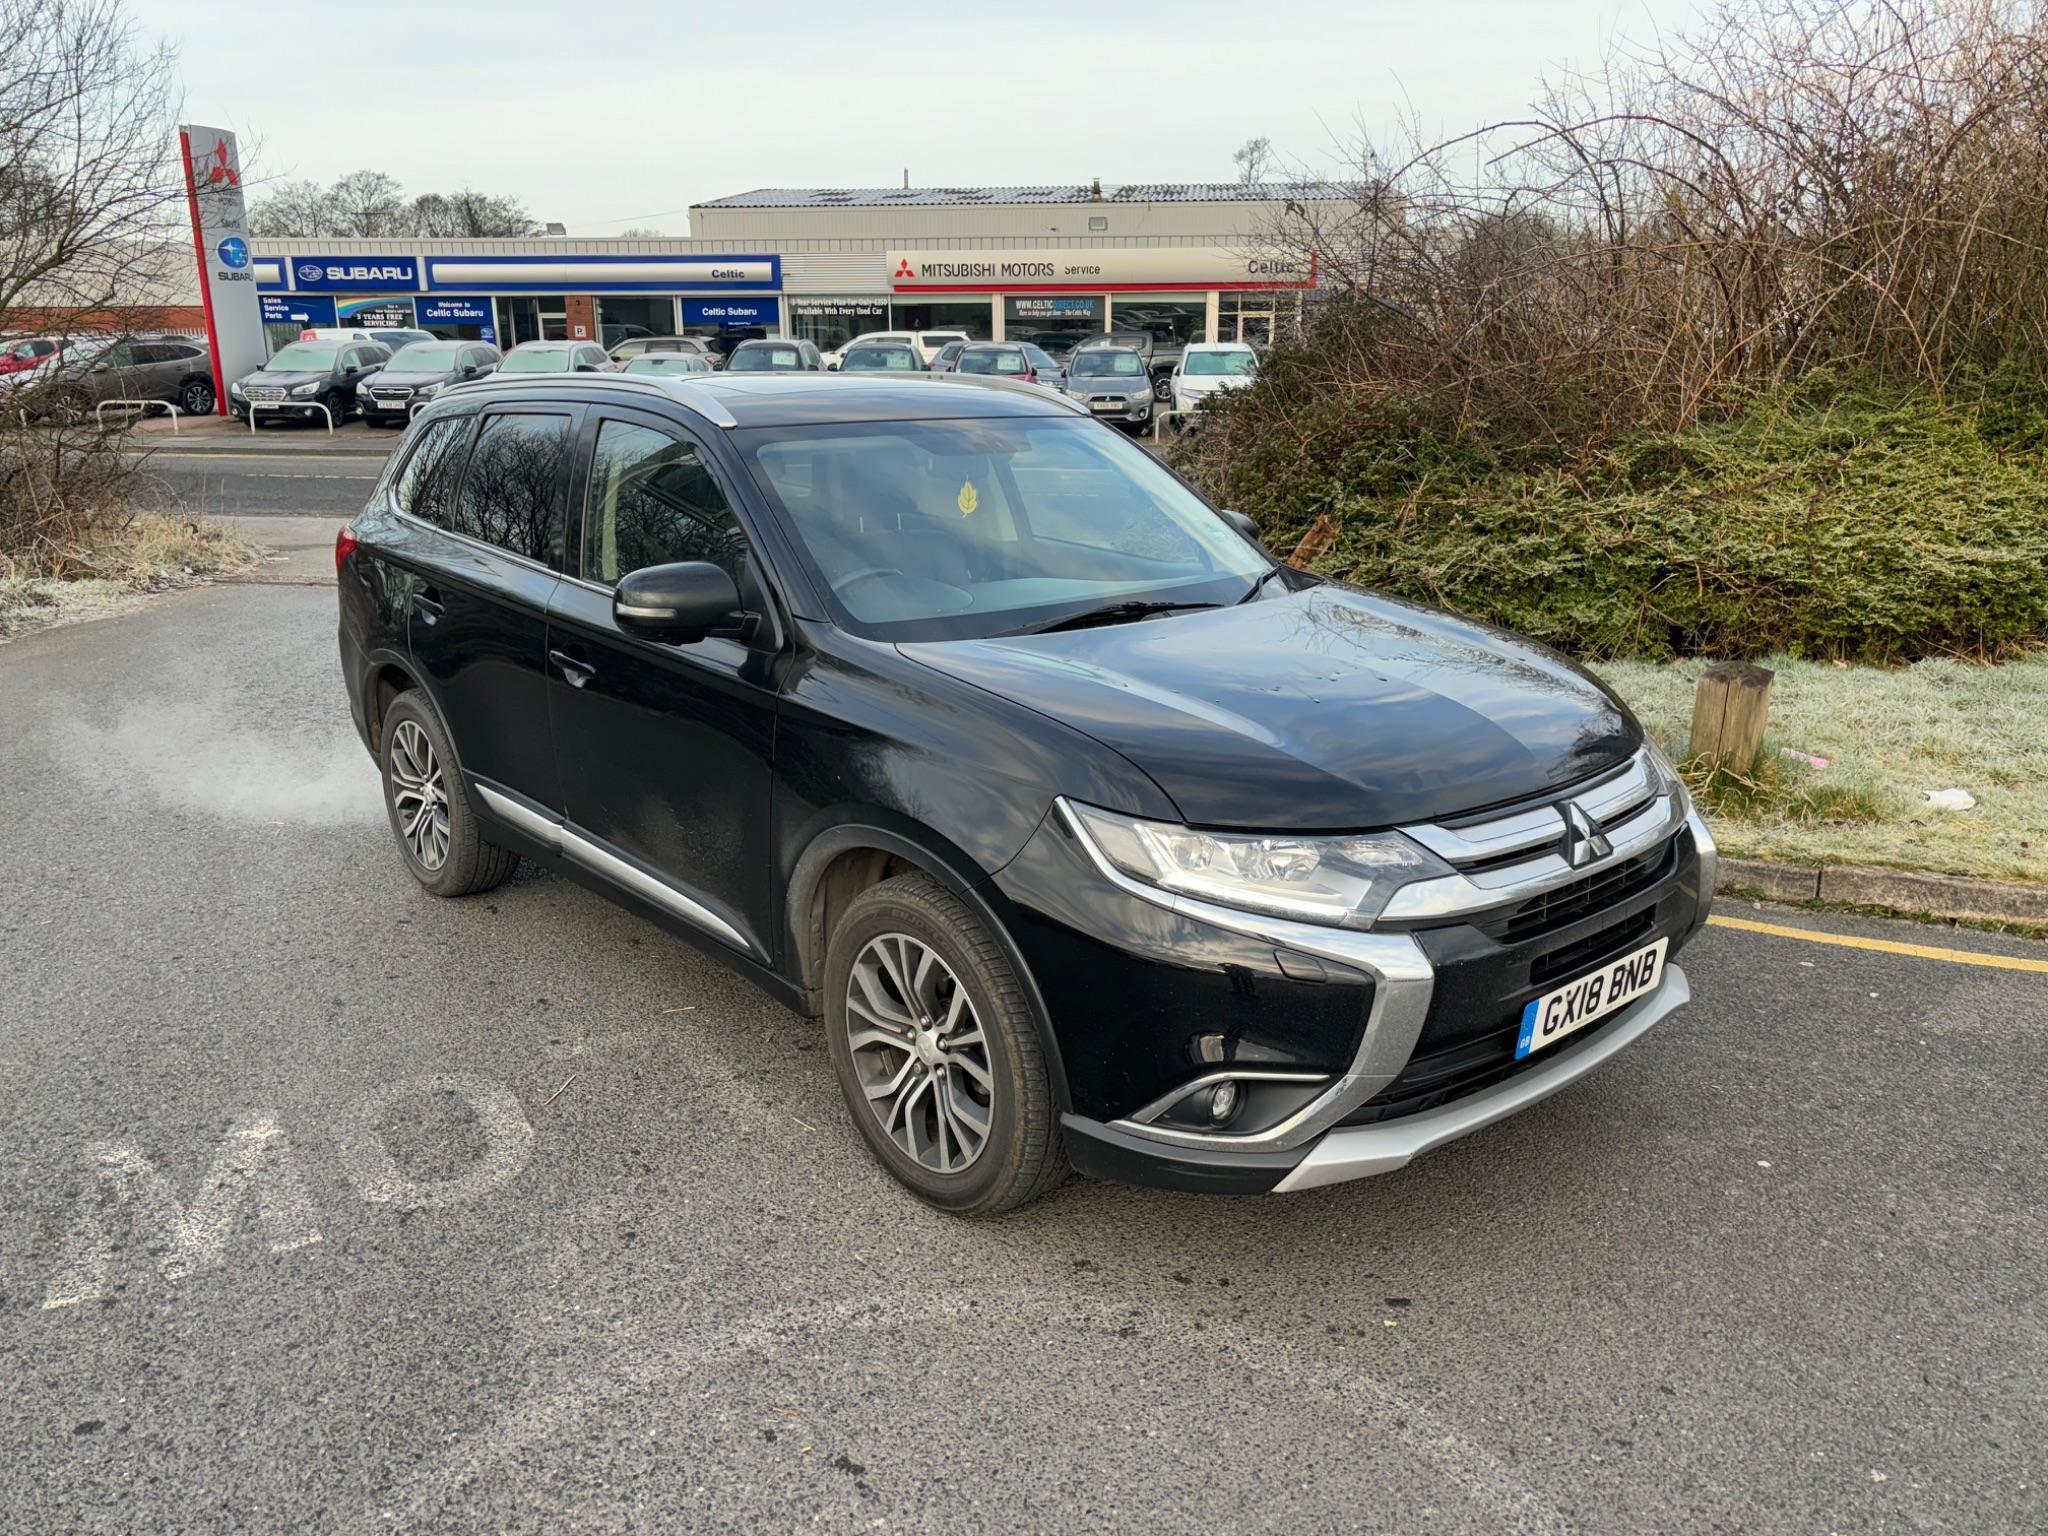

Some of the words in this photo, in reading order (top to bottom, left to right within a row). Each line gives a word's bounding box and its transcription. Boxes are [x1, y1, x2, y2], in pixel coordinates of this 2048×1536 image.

[326, 266, 412, 280] SUBARU
[921, 262, 996, 278] MITSUBISHI
[1001, 262, 1055, 278] MOTORS
[1064, 264, 1101, 275] Service
[1248, 260, 1294, 274] Celtic
[218, 271, 253, 282] SUBARU
[711, 269, 745, 279] Celtic
[426, 308, 451, 317] Celtic
[453, 308, 484, 317] Subaru
[702, 307, 726, 316] Celtic
[727, 307, 757, 316] Subaru
[797, 306, 823, 315] Available
[824, 306, 838, 315] With
[839, 307, 855, 317] Every
[872, 307, 882, 315] Car
[1542, 974, 1604, 1036] GX18
[1606, 948, 1657, 1005] BNB
[1519, 1035, 1531, 1049] GB
